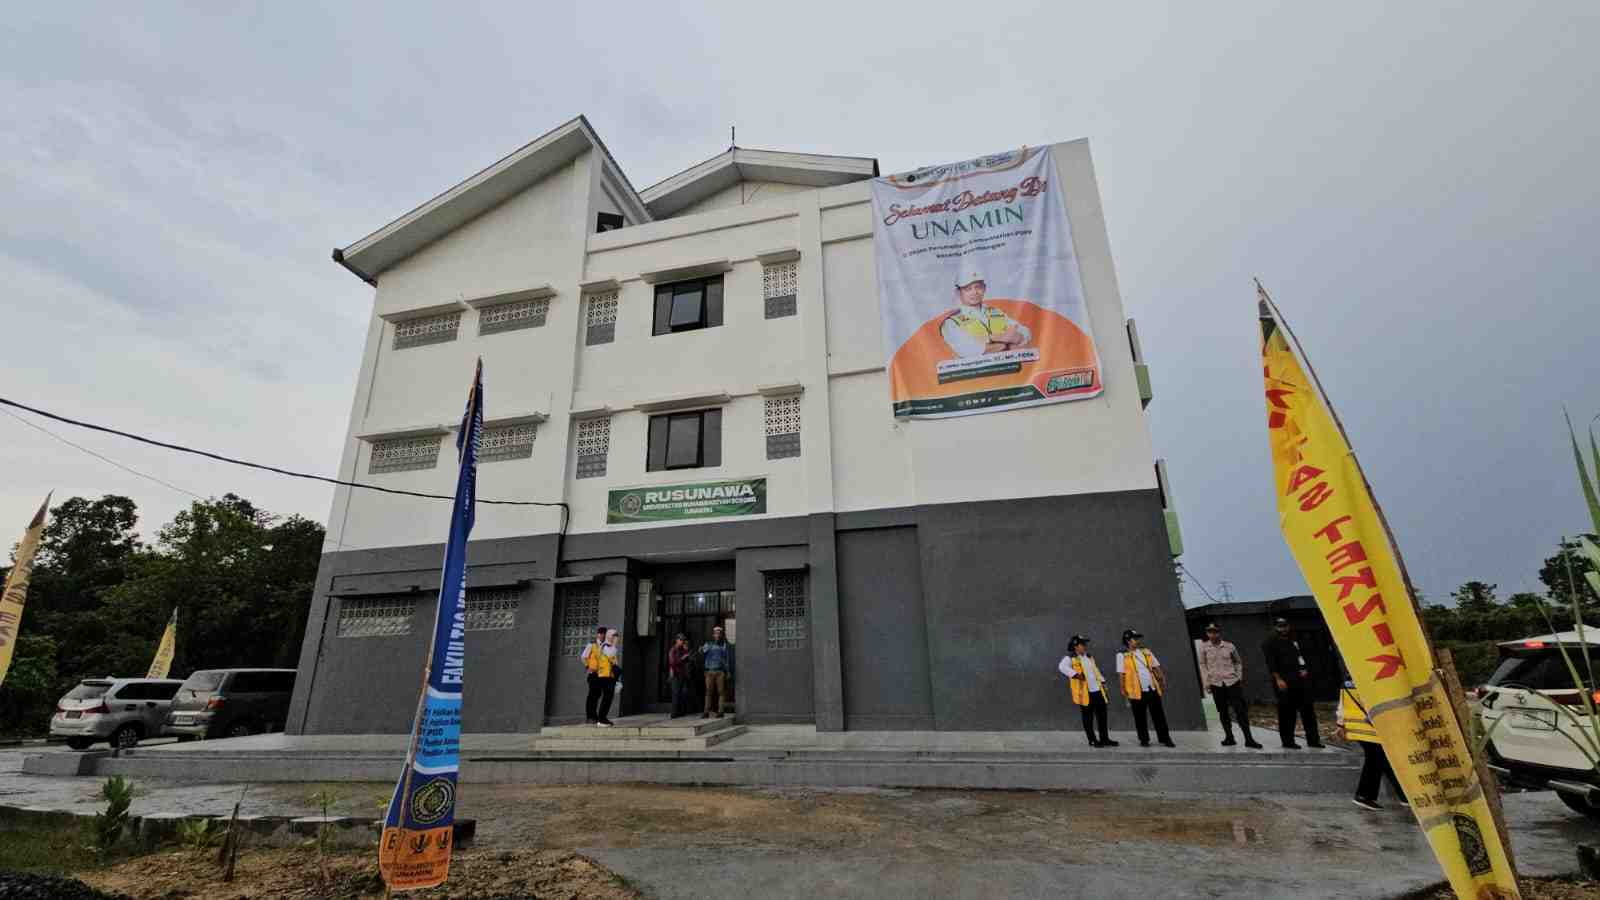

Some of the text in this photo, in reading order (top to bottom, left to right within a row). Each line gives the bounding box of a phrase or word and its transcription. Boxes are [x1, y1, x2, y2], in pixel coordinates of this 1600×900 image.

[884, 202, 951, 225] Selamat
[951, 187, 1018, 213] Datang
[911, 203, 1025, 241] UNAMIN
[645, 485, 754, 503] RUSUNAWA
